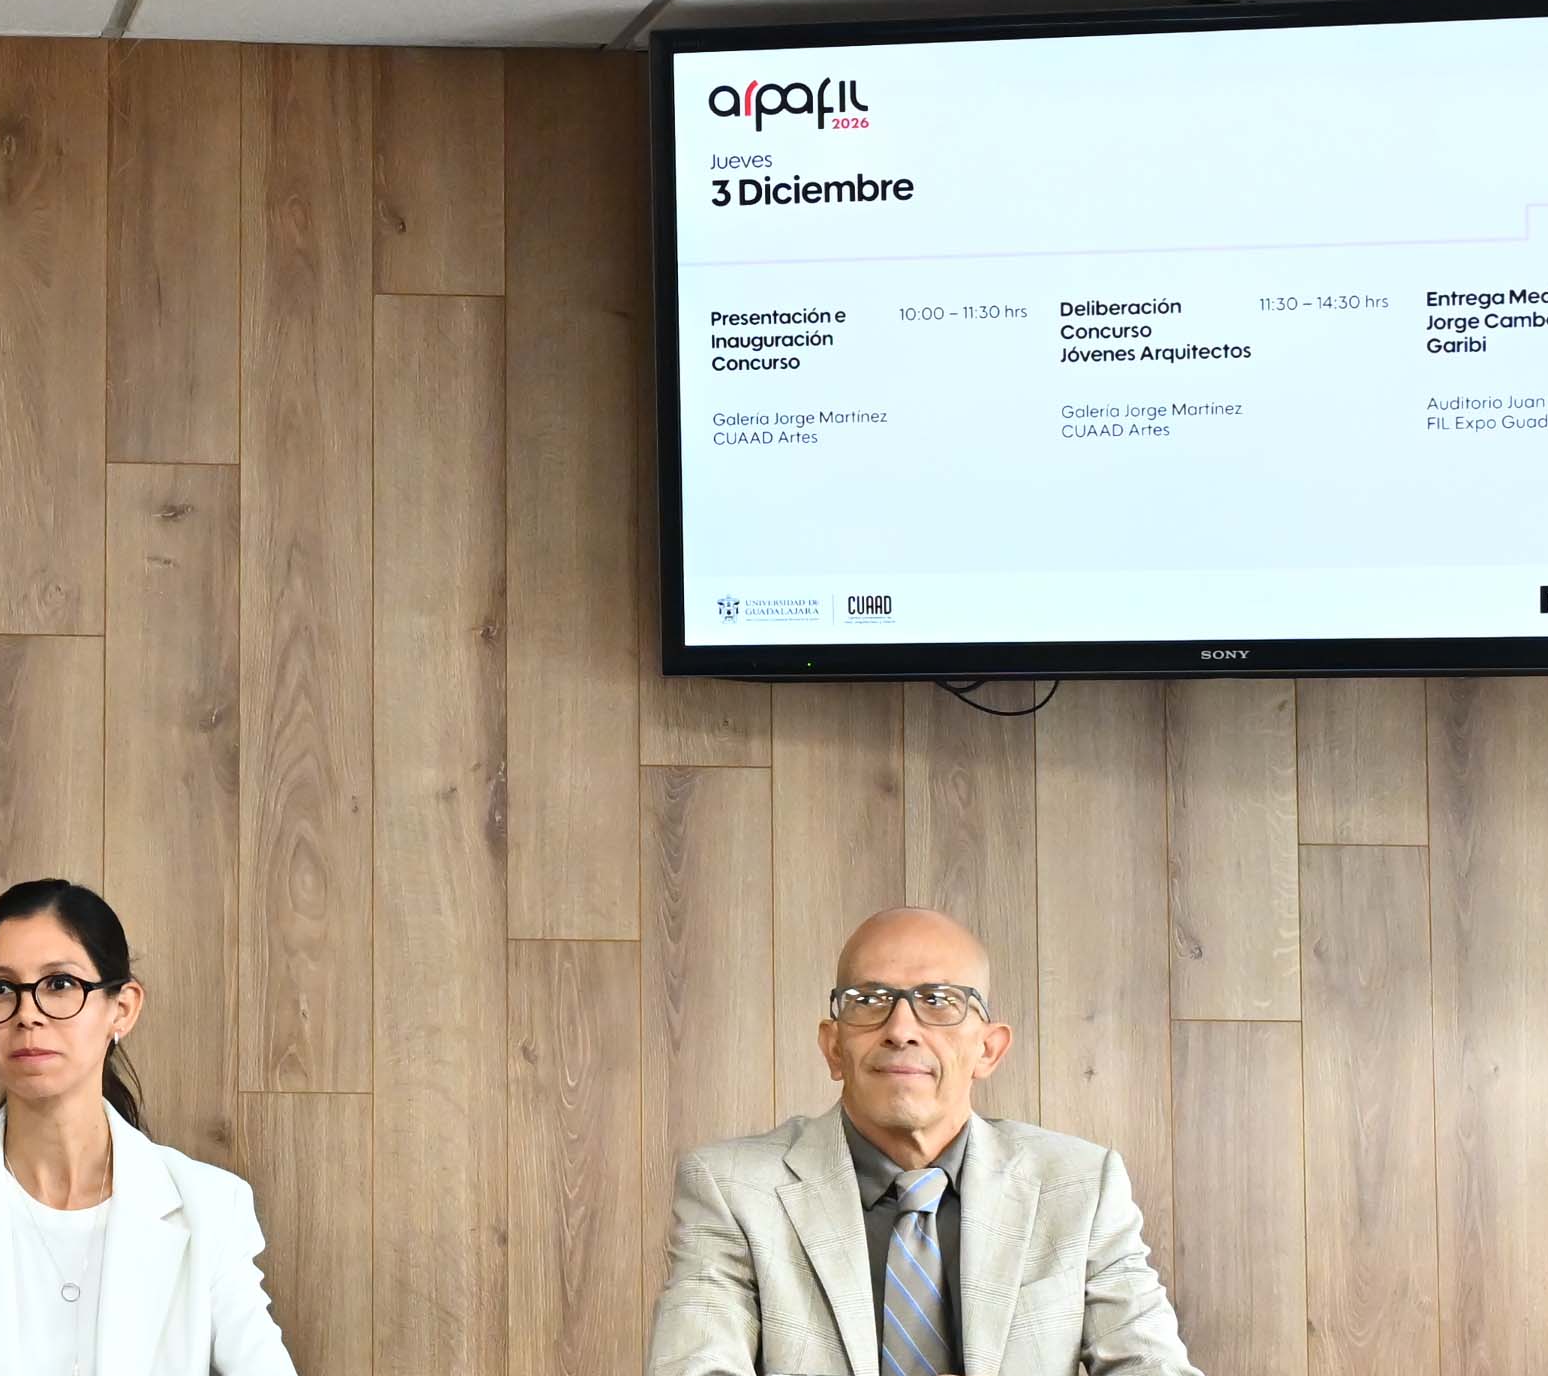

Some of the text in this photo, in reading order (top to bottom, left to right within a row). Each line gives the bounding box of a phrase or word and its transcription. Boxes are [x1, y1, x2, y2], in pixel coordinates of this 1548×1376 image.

[831, 117, 870, 130] 2026
[710, 153, 773, 170] Jueves
[711, 173, 915, 207] 3 Diciembre
[1060, 298, 1182, 317] Deliberación
[1259, 296, 1298, 312] 11:30
[1317, 295, 1360, 311] 14:30
[1365, 295, 1390, 310] hrs
[1426, 291, 1505, 310] Entrega
[710, 307, 847, 327] Presentación e
[898, 306, 945, 321] 10:00
[962, 305, 1000, 320] 11:30
[1005, 304, 1028, 319] hrs
[1060, 324, 1153, 340] Concurso
[1426, 314, 1480, 334] Jorge
[711, 330, 834, 352] Inauguración
[1426, 336, 1487, 354] Garibi
[1060, 343, 1252, 364] Jóvenes Arquitectos
[712, 355, 801, 372] Concurso
[1427, 396, 1503, 411] Auditorio
[1506, 395, 1545, 410] Juan
[774, 411, 815, 428] Jorge
[819, 409, 888, 424] Martínez
[1124, 403, 1167, 421] Jorge
[1061, 423, 1171, 439] CUAAD Artes
[1427, 416, 1450, 431] FIL
[1455, 416, 1497, 433] Expo
[713, 429, 818, 446] CUAAD Artes
[848, 595, 893, 615] CUAAD
[1200, 650, 1250, 660] SONY
